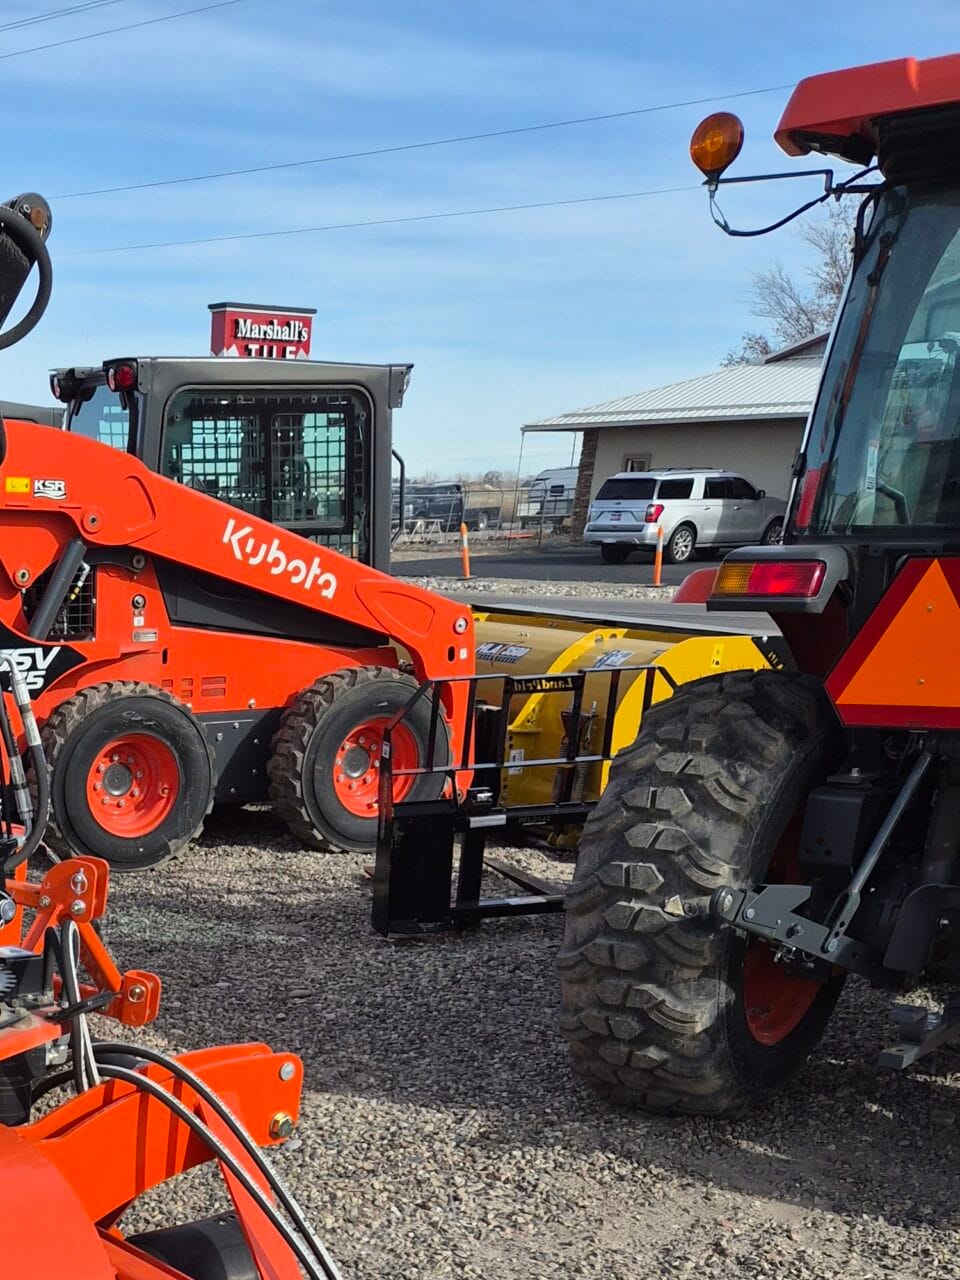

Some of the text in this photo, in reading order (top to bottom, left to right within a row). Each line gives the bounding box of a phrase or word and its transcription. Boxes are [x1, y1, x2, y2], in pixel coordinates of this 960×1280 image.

[237, 318, 308, 341] Marshall's
[34, 479, 66, 492] KSR
[222, 518, 337, 600] Kubota
